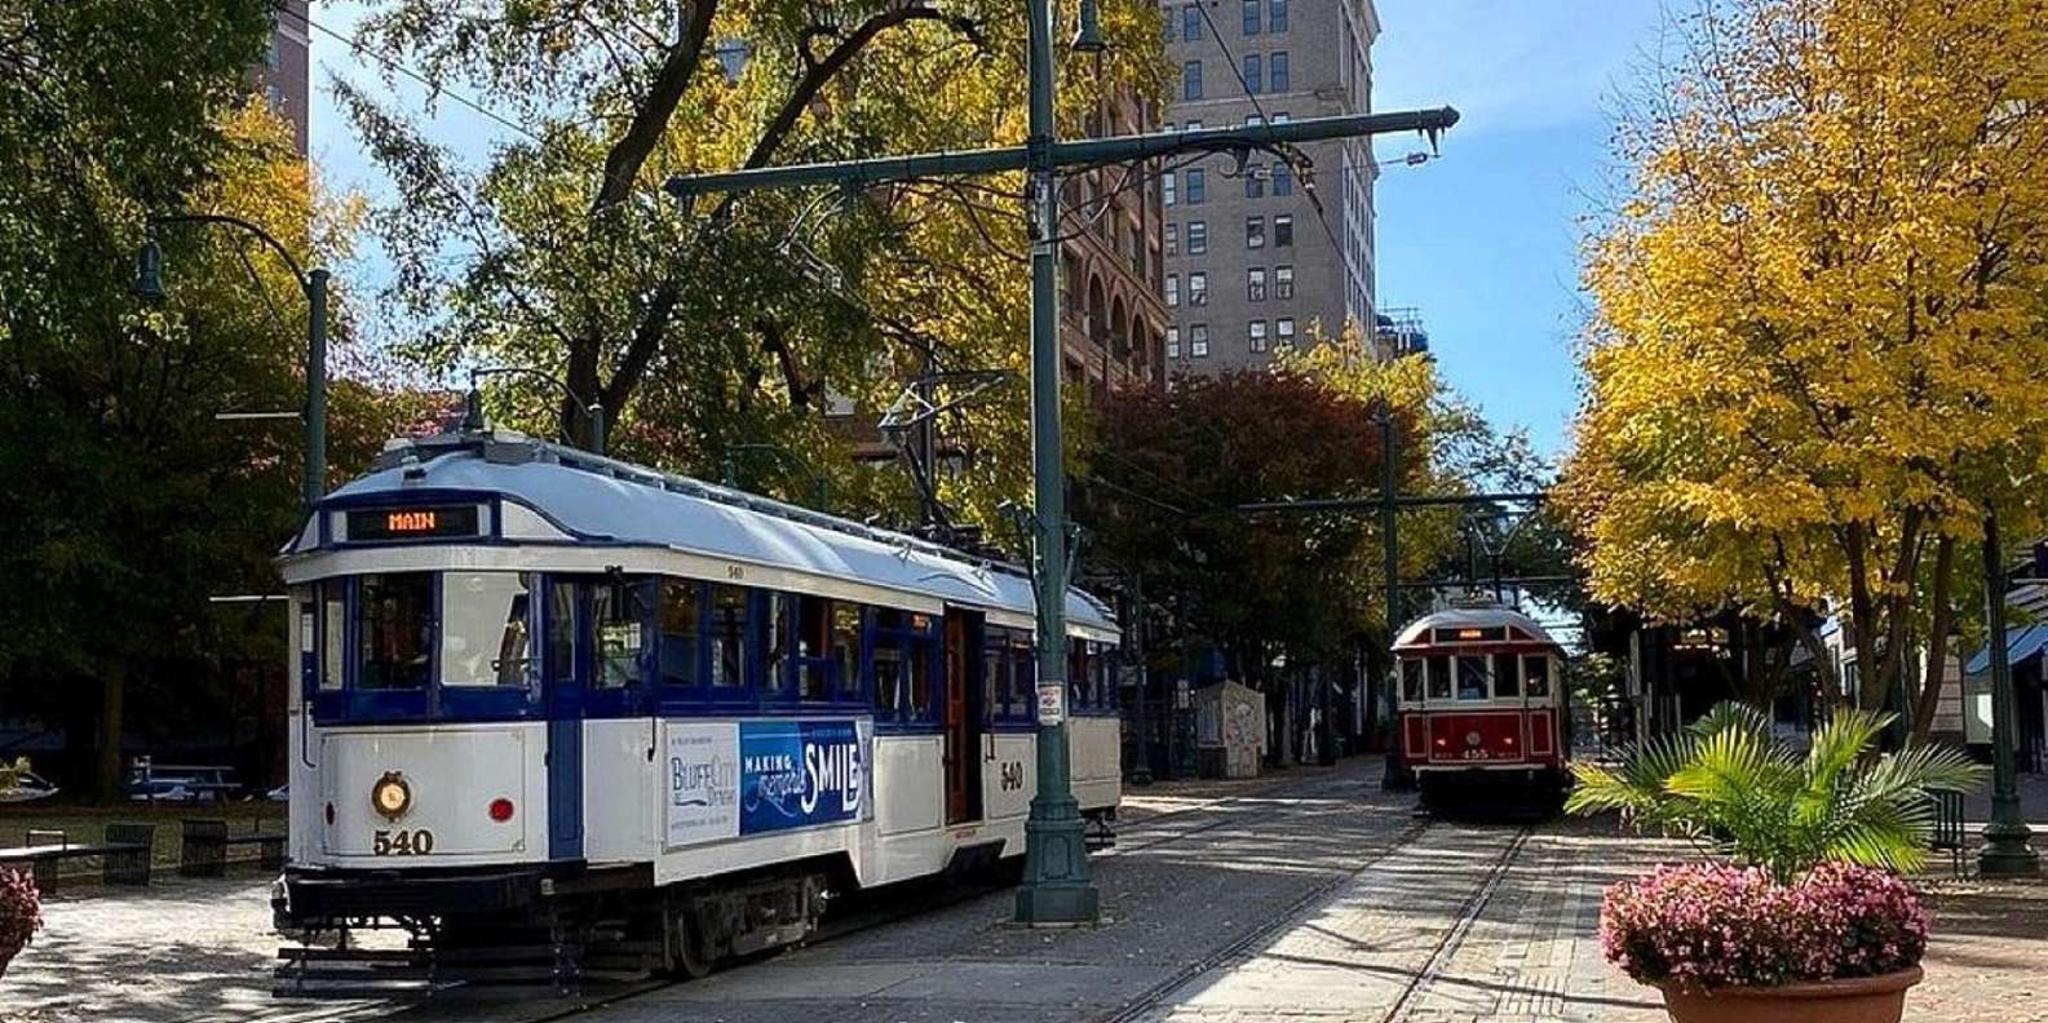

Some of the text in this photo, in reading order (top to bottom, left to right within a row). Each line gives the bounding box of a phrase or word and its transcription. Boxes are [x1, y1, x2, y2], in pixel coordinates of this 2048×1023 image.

[388, 512, 435, 531] MAIN
[744, 754, 793, 774] MAKING
[1001, 761, 1023, 791] 540
[800, 742, 860, 814] SMILE
[373, 829, 433, 856] 540
